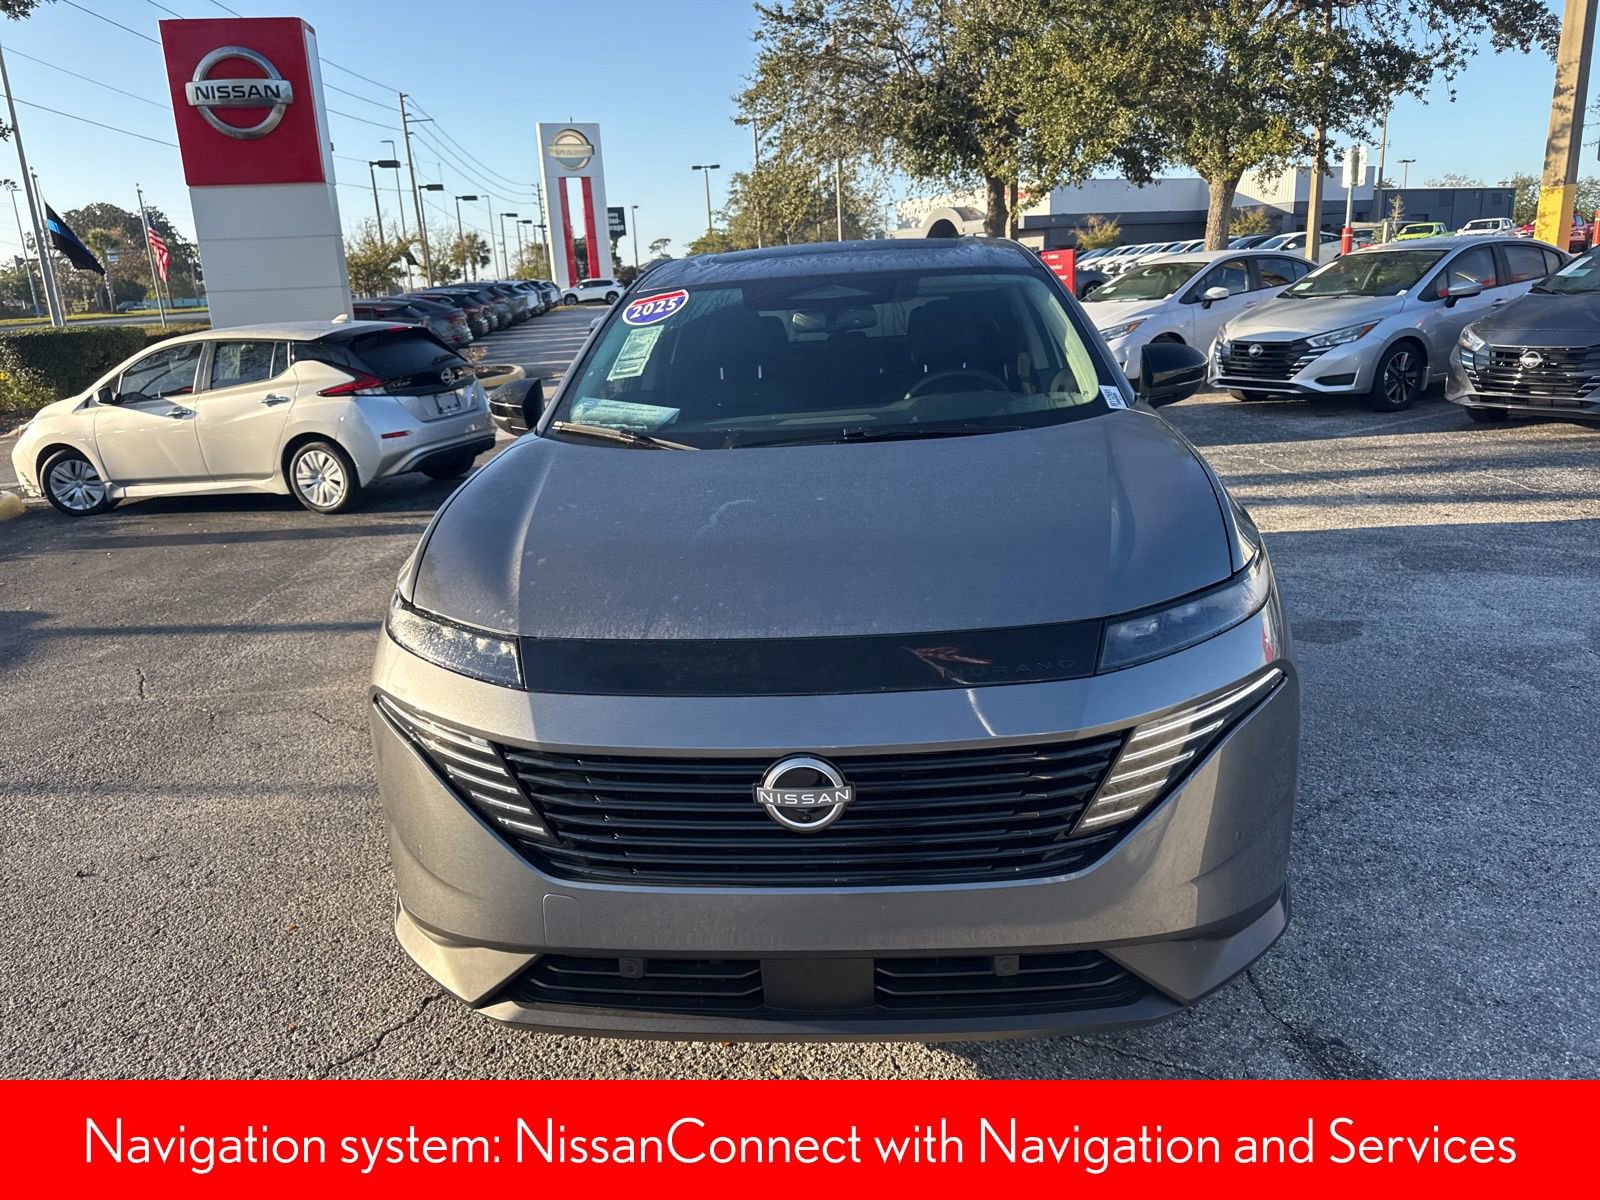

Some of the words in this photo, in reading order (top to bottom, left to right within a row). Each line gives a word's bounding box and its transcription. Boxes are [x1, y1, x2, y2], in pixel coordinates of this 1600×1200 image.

[195, 84, 281, 101] NISSAN
[629, 297, 679, 319] 2025
[760, 789, 849, 804] NISSAN
